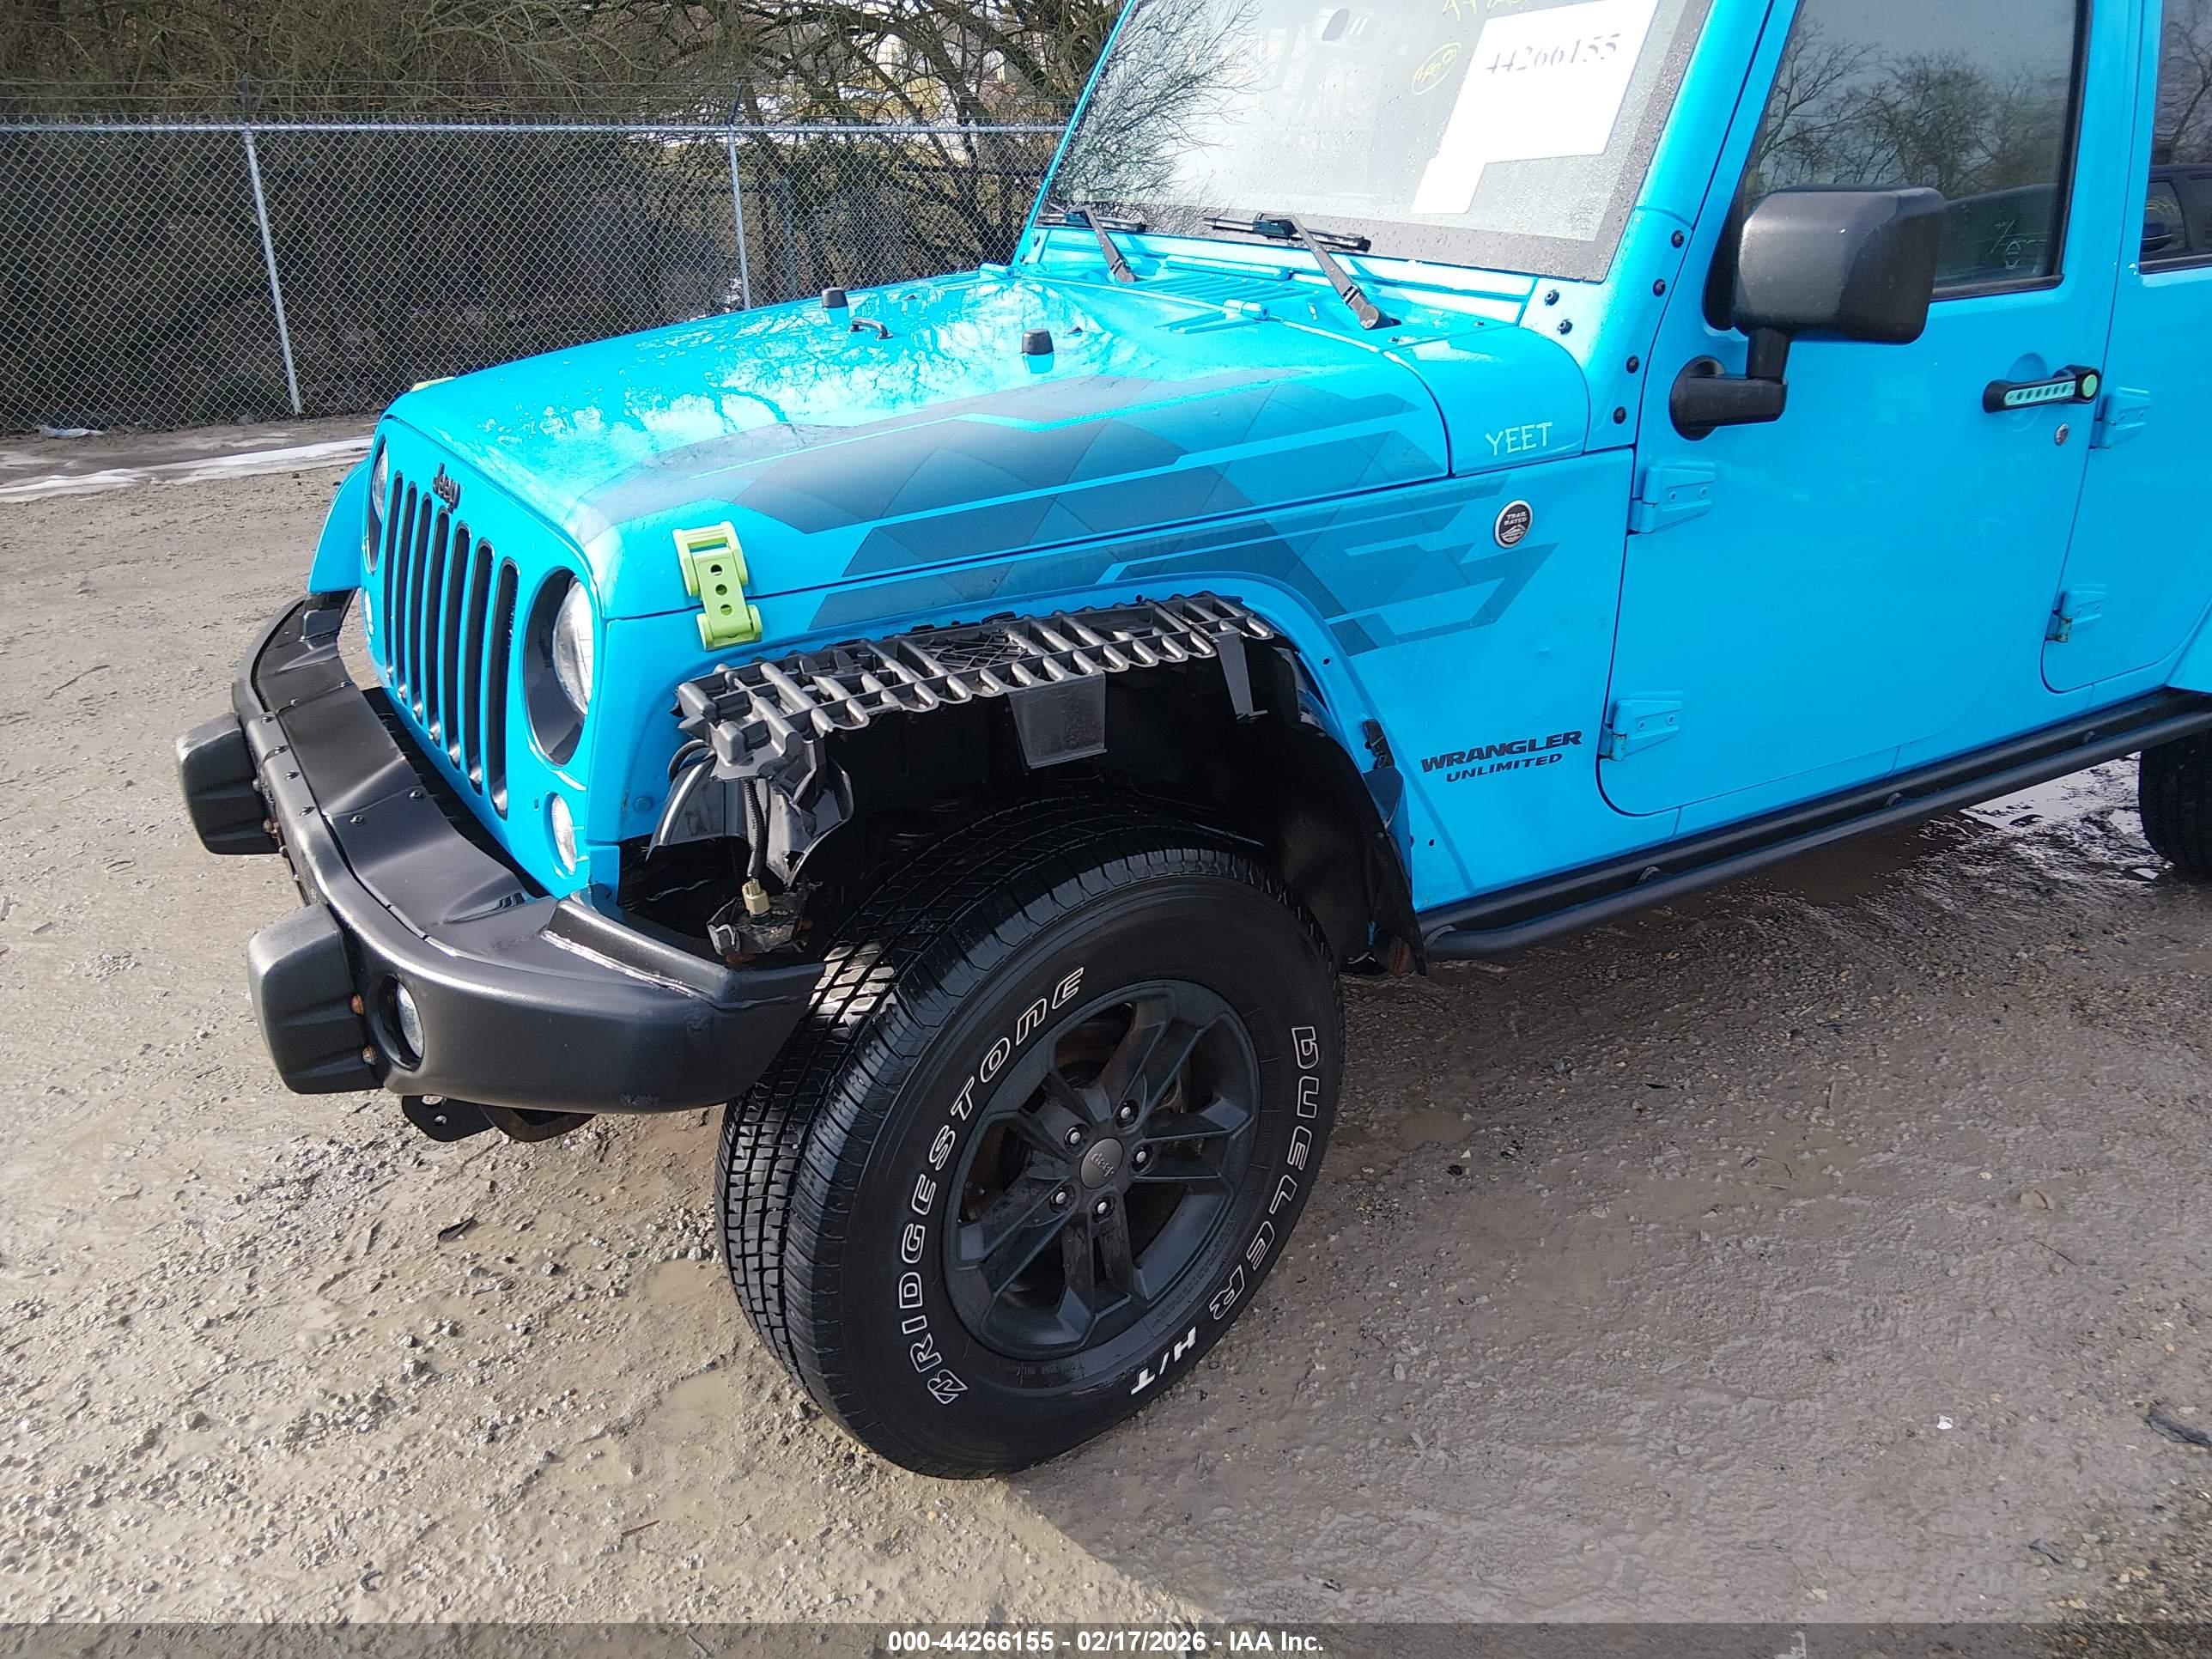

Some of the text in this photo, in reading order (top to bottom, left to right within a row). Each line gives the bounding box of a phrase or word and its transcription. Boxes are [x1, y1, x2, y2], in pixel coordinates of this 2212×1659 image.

[1485, 422, 1553, 456] YEET
[1421, 730, 1583, 773] WRANGLER
[1446, 753, 1563, 783] UNLIMITED
[899, 967, 1085, 1405] BRIDGESTONE
[1130, 1025, 1320, 1395] DUELER H/T
